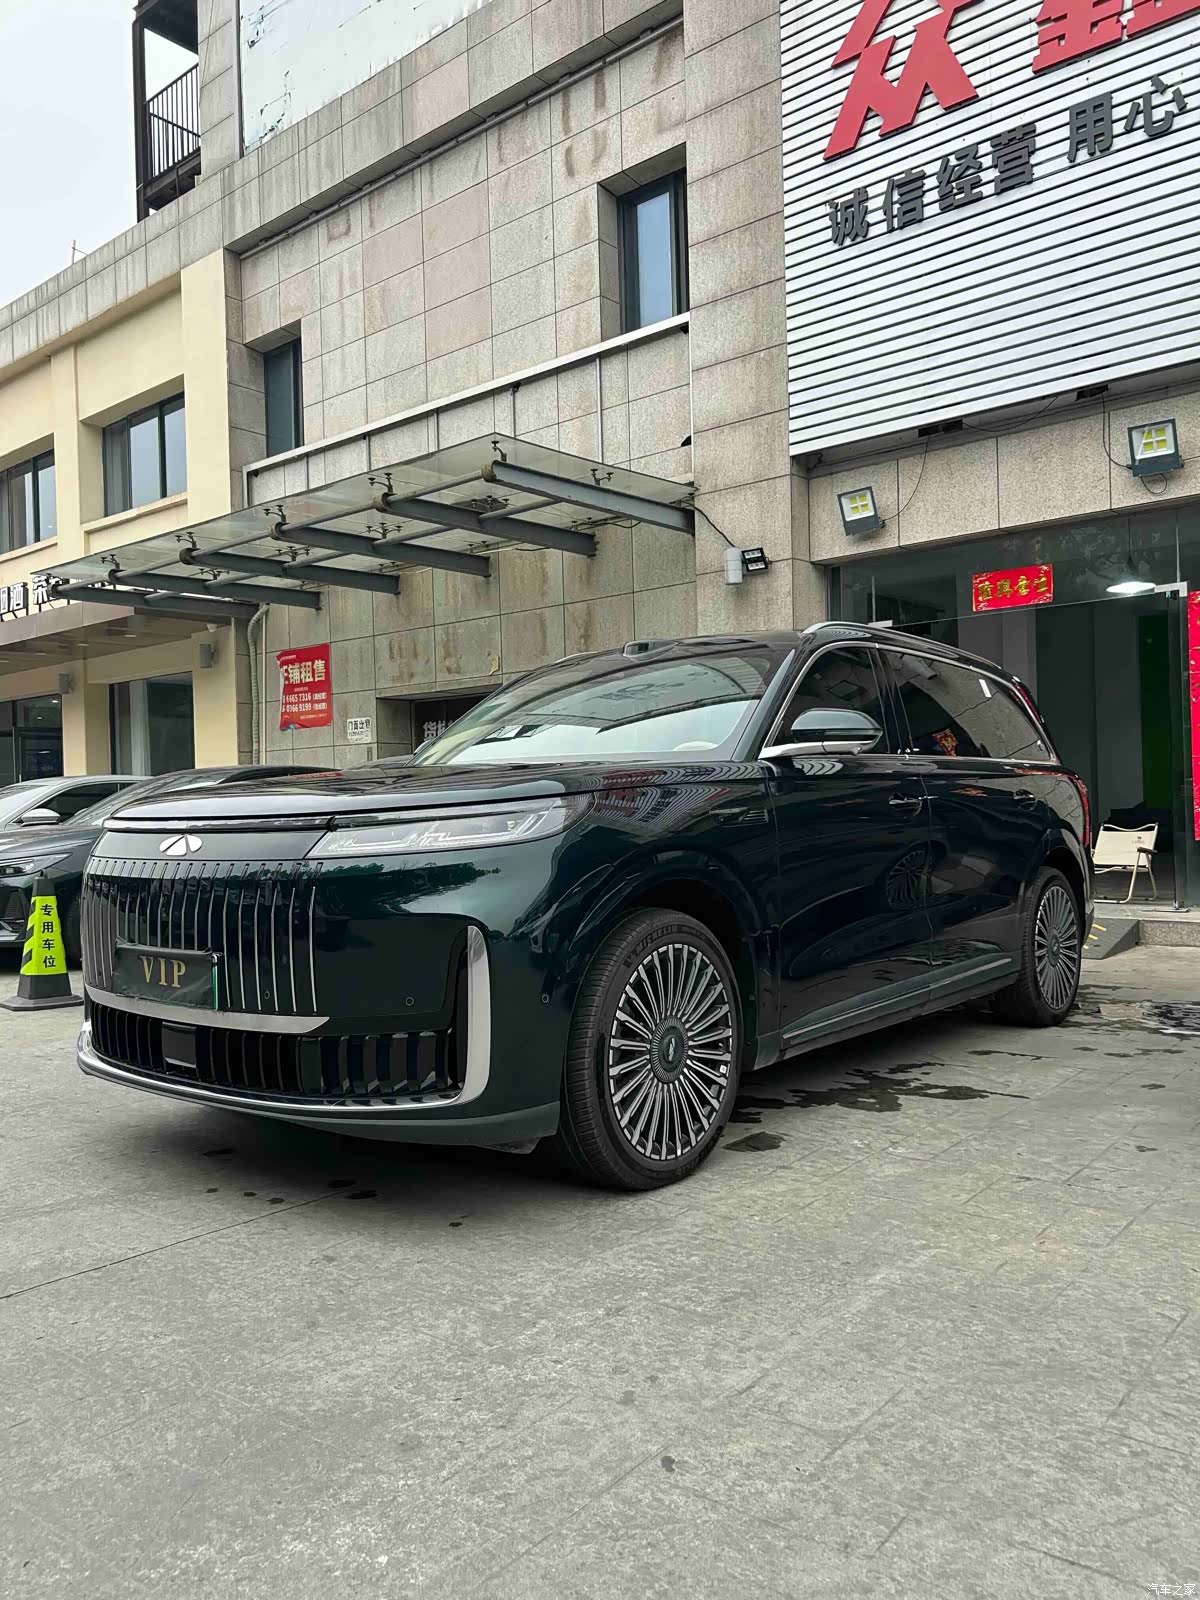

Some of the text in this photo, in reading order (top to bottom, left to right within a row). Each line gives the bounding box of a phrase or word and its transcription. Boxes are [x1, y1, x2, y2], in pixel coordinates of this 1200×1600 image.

[825, 74, 1188, 246] 诚信经营 用心
[40, 903, 57, 969] 专用车位
[138, 955, 186, 988] VIP
